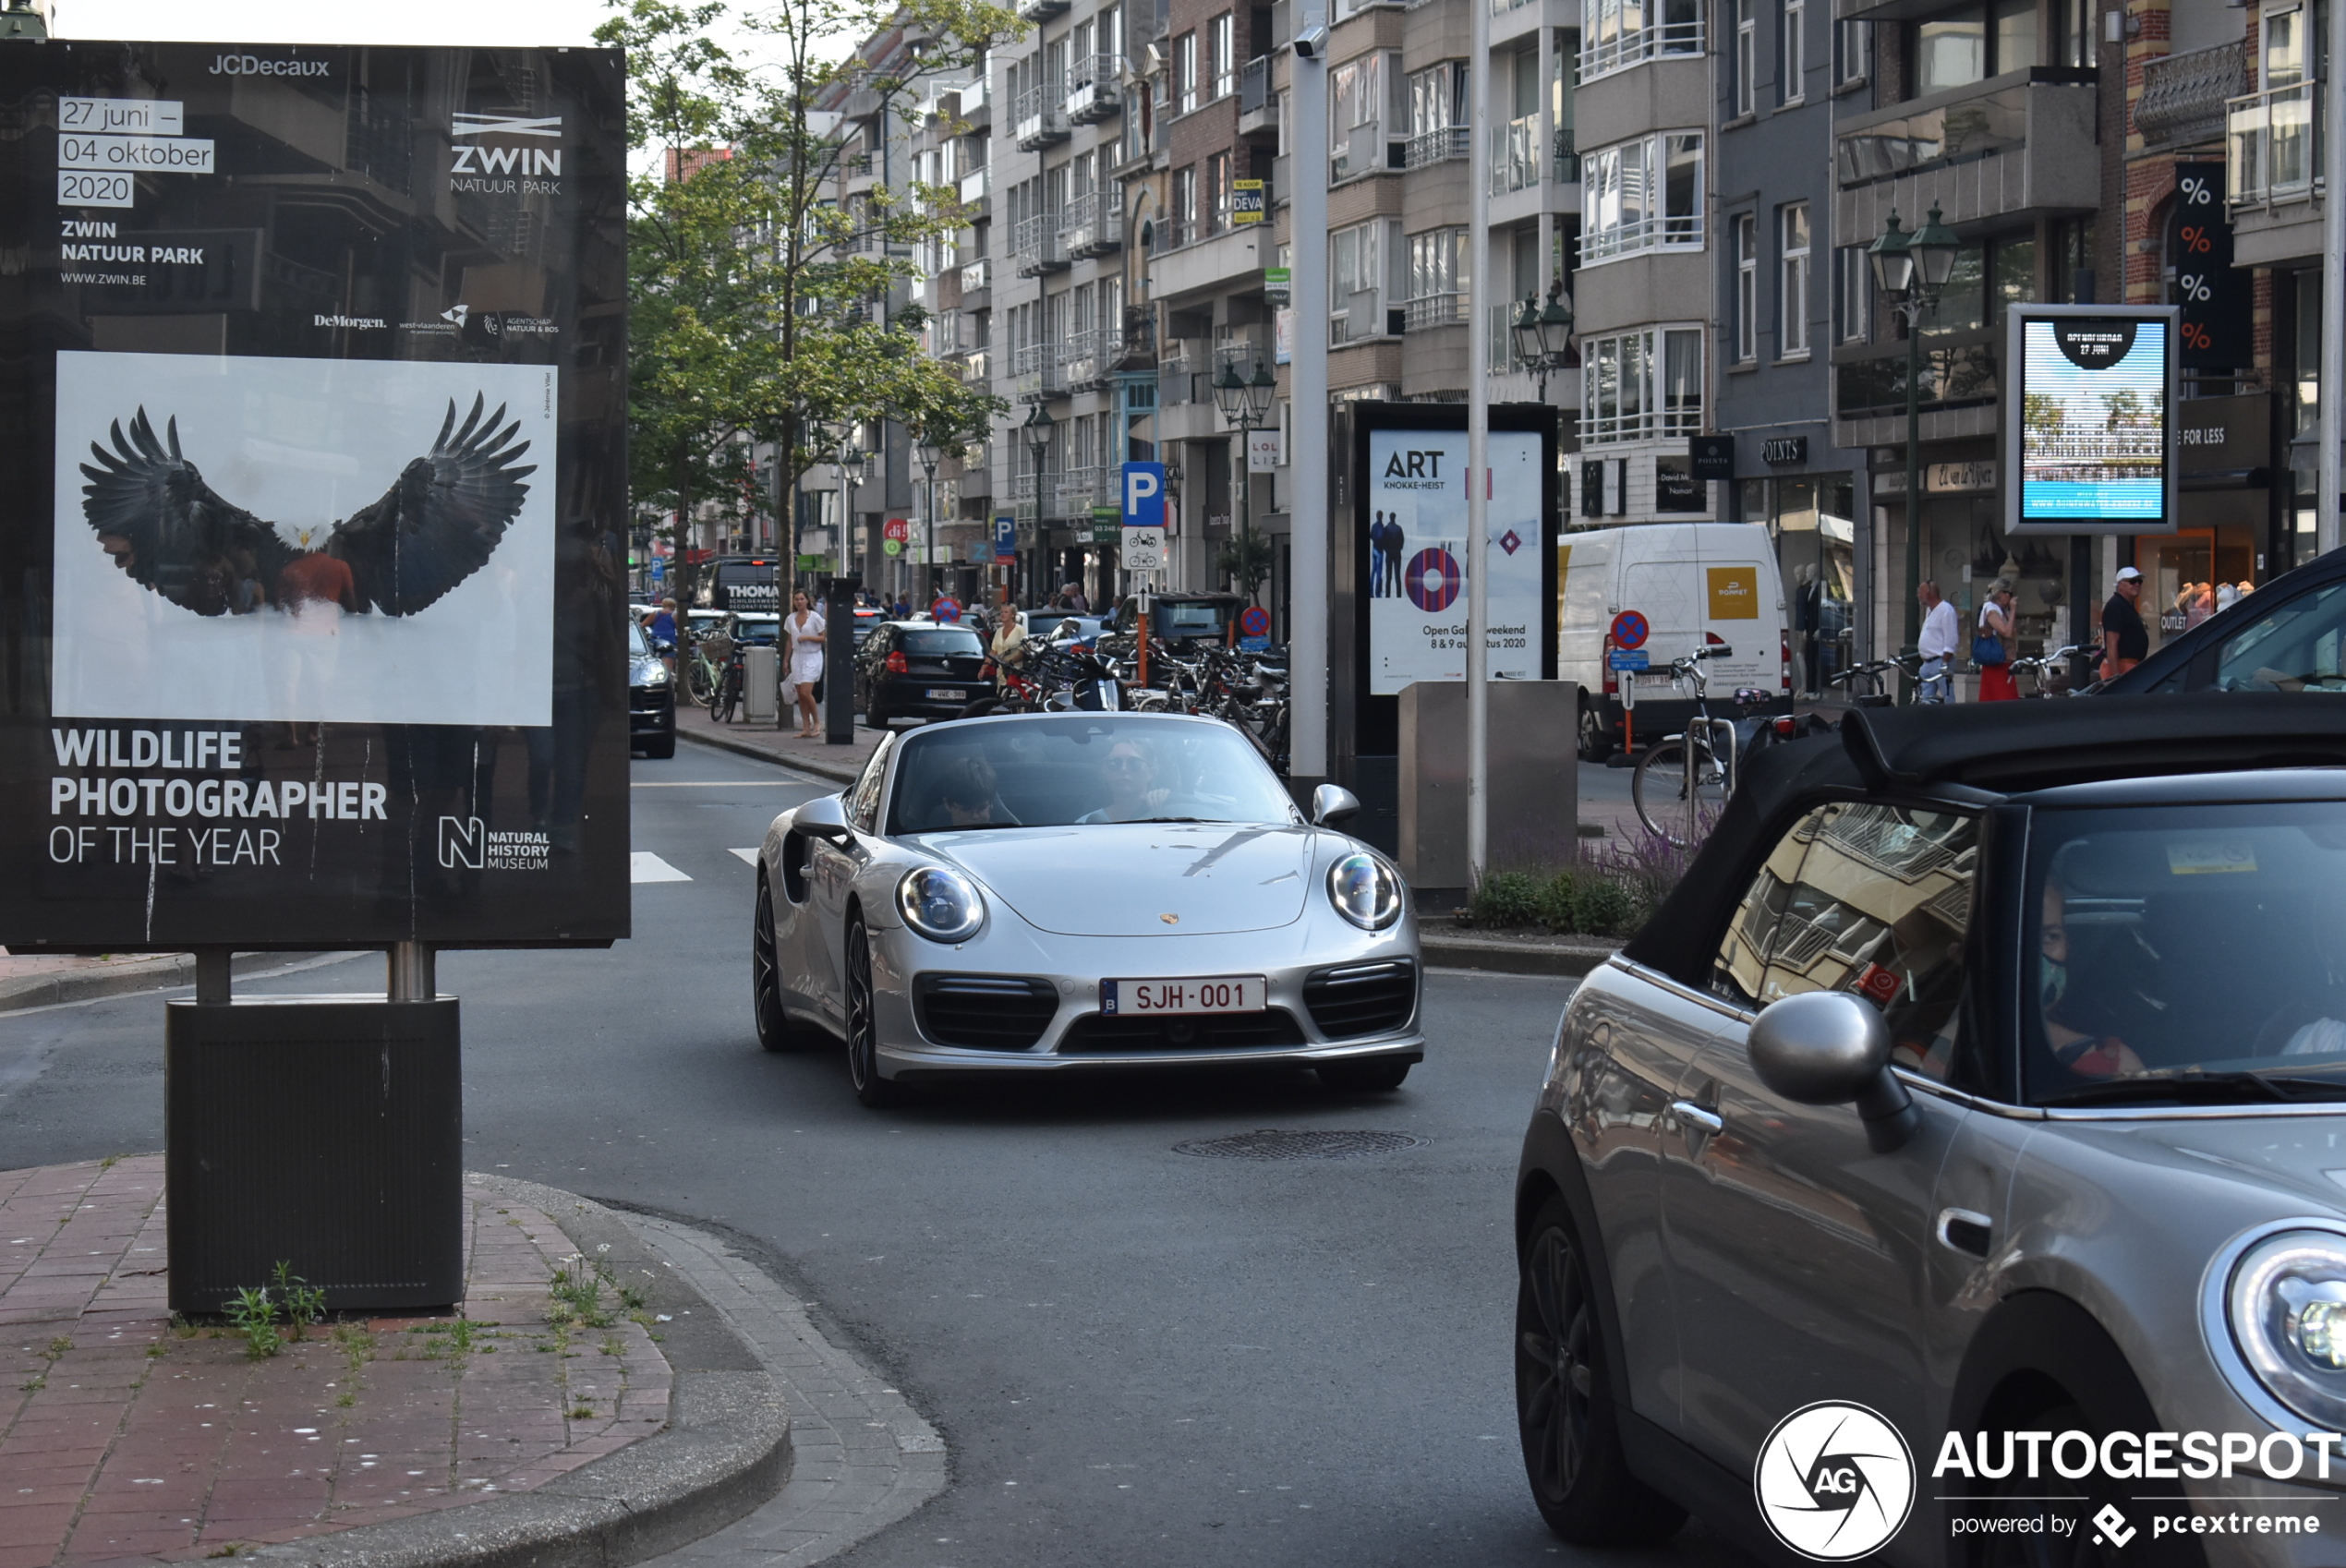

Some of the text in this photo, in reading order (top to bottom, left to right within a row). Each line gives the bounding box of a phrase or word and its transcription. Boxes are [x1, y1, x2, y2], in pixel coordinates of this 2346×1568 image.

[209, 54, 330, 76] JCDecaux
[64, 102, 94, 124] 27
[100, 103, 149, 131] juni
[64, 139, 211, 165] 04 oktober
[451, 145, 561, 176] ZWIN
[63, 176, 128, 200] 2020
[450, 178, 561, 195] NATUUR PARK
[2181, 177, 2211, 205] %
[1233, 197, 1262, 211] DEVA
[61, 221, 116, 238] ZWIN
[2181, 226, 2211, 253] %
[62, 244, 203, 264] NATUUR PARK
[61, 272, 147, 285] WWW.ZWIN.BE
[2181, 274, 2211, 301] %
[314, 314, 387, 331] DeMorgen.
[399, 321, 455, 331] west-vlaanderen
[2181, 322, 2211, 350] %
[2183, 428, 2202, 445] FOR
[2204, 427, 2225, 444] LESS
[1760, 439, 1797, 462] POINTS
[1385, 449, 1445, 478] ART
[1128, 470, 1158, 515] P
[1384, 481, 1445, 489] KNOKKE-HEIST
[998, 521, 1012, 542] P
[652, 560, 661, 573] P
[1422, 624, 1449, 637] Open
[2161, 615, 2187, 631] OUTLET
[1431, 639, 1437, 648] 8
[1439, 639, 1446, 648] &
[1448, 638, 1455, 648] 9
[1503, 638, 1526, 648] 2020
[52, 729, 241, 769] WILDLIFE
[52, 777, 387, 820] PHOTOGRAPHER
[49, 826, 281, 866] OF THE YEAR
[488, 831, 550, 844] NATURAL
[488, 844, 550, 857] HISTORY
[488, 857, 549, 870] MUSEUM
[1106, 983, 1243, 1010] B SJH-001
